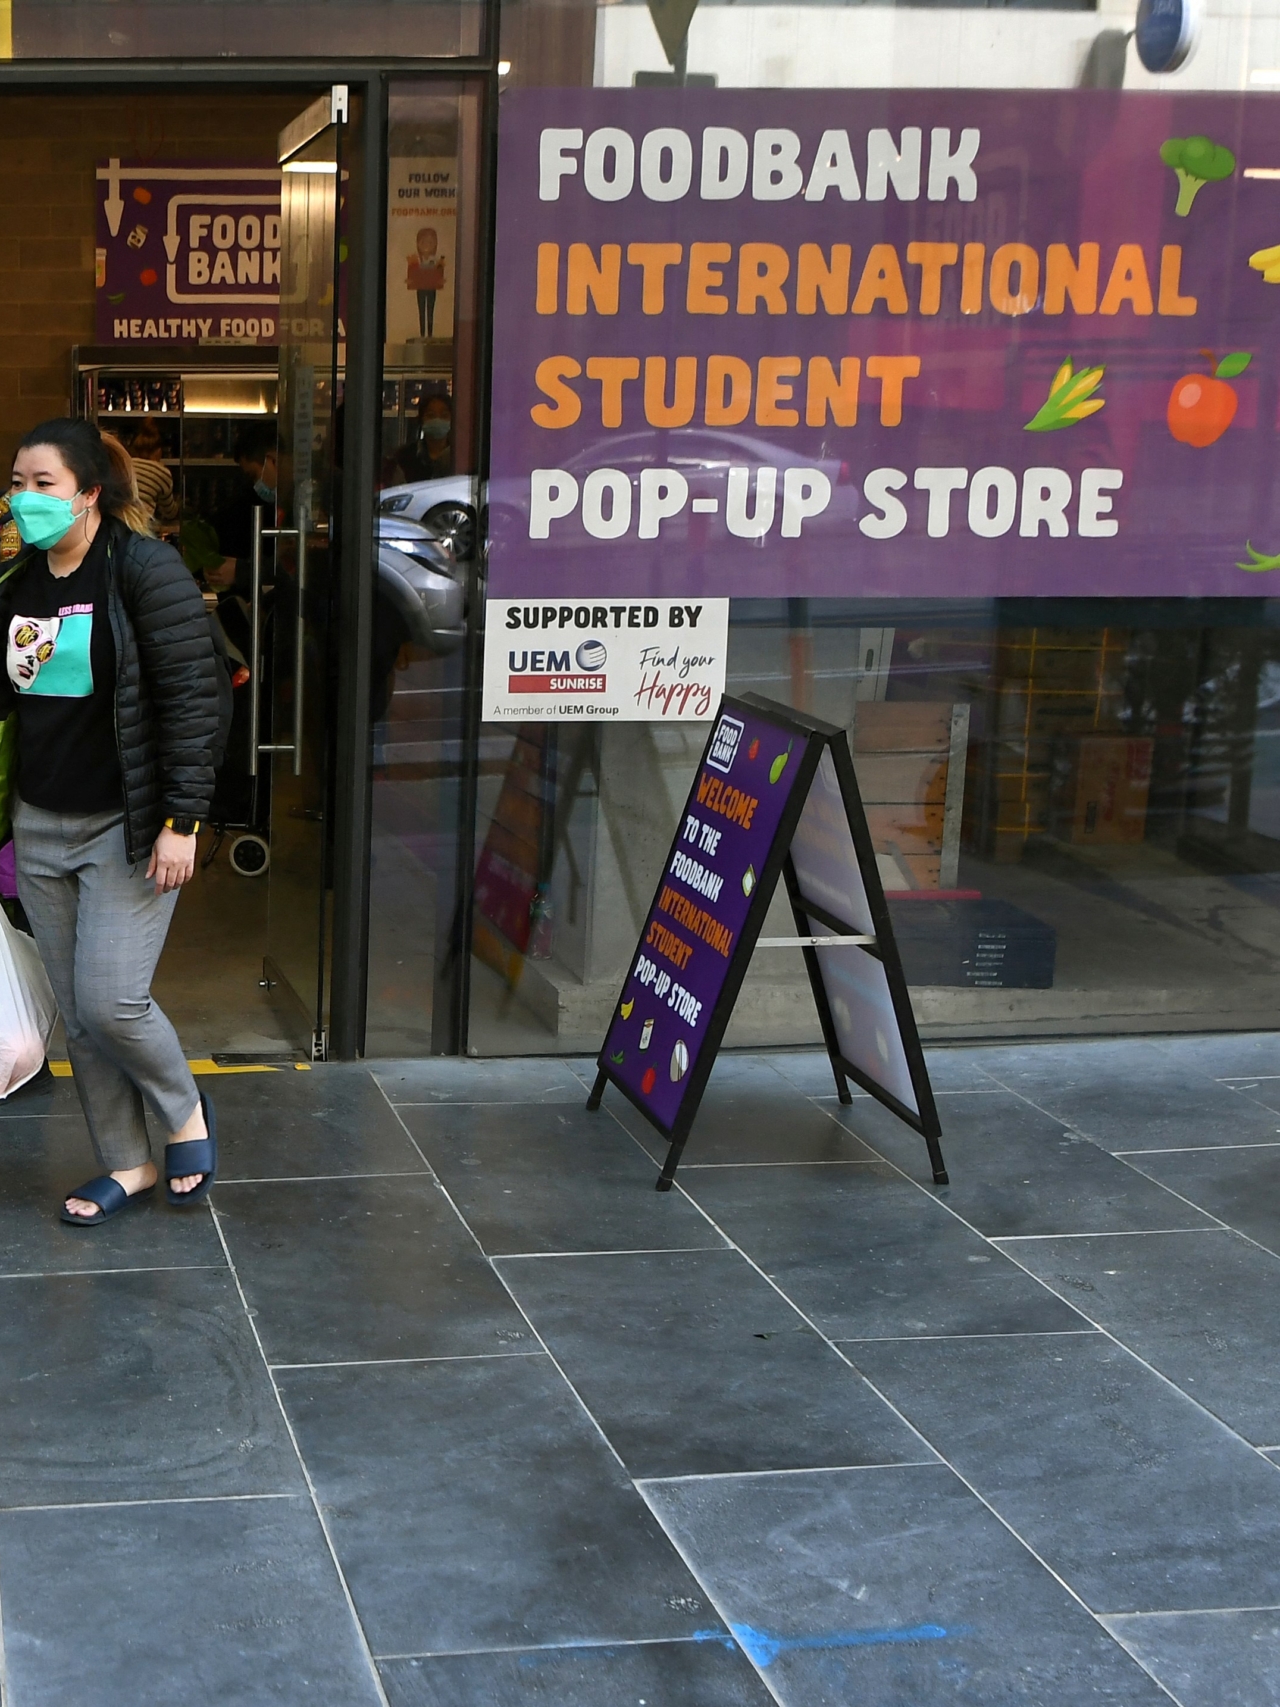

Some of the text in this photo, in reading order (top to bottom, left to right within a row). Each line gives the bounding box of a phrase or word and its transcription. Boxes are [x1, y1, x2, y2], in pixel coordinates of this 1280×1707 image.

[408, 172, 450, 184] FOLLOW
[539, 127, 980, 202] FOODBANK
[398, 188, 420, 198] OUR
[188, 215, 281, 249] FOOD
[188, 252, 280, 285] BANK
[536, 243, 1197, 315] INTERNATIONAL
[114, 318, 212, 338] HEALTHY
[221, 318, 275, 338] FOOD
[530, 355, 921, 428] STUDENT
[529, 467, 1122, 539] POP-UP STORE
[506, 606, 702, 629] SUPPORTED BY
[509, 651, 570, 672] UEM
[640, 646, 716, 678] Find your
[550, 678, 603, 690] SUNRISE
[634, 670, 712, 716] Happy
[494, 705, 619, 716] A member of UEM Group
[718, 724, 738, 746] FOOD
[712, 742, 734, 764] BANK
[696, 772, 758, 830] WELCOME
[683, 814, 722, 856] TO THE
[670, 850, 724, 903] FOODBANK
[658, 885, 734, 958] INTERNATIONAL
[646, 921, 694, 970] STUDENT
[634, 954, 703, 1028] POP-UP STORE
